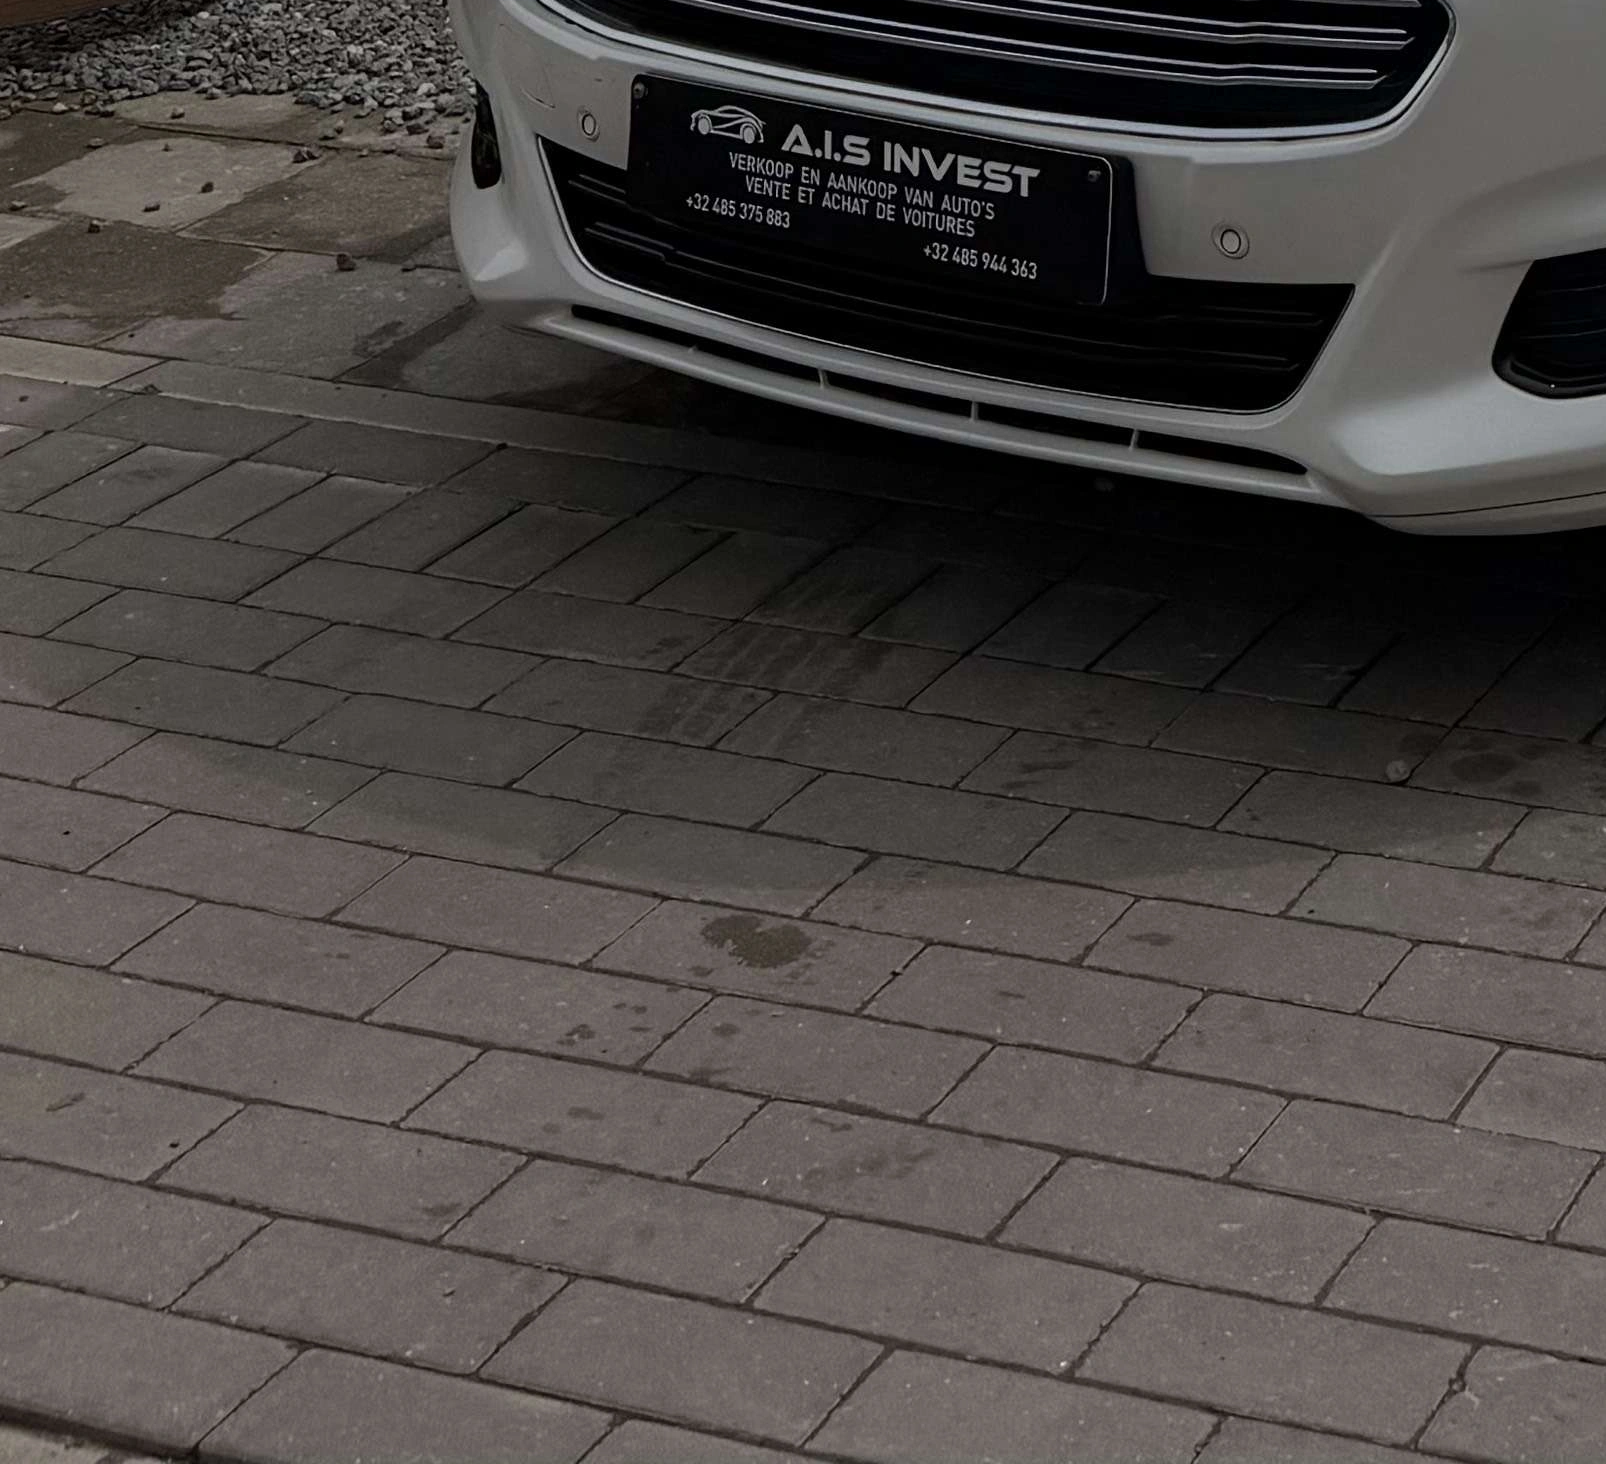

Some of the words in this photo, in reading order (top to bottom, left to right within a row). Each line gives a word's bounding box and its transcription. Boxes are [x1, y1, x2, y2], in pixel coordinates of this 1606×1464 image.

[728, 151, 795, 179] VERKOOP
[800, 166, 821, 186] EN
[827, 171, 898, 201] AANKOOP
[904, 185, 934, 209] VAN
[940, 193, 996, 220] AUTO'S
[780, 123, 871, 167] A.I.S
[883, 140, 1041, 198] INVEST
[685, 192, 710, 212] +32
[711, 197, 737, 217] 485
[739, 202, 764, 223] 375
[765, 207, 791, 229] 883
[745, 174, 791, 200] VENTE
[797, 186, 816, 205] ET
[821, 191, 870, 217] ACHAT
[875, 201, 897, 222] DE
[902, 206, 976, 238] VOITURES
[923, 241, 949, 262] +32
[952, 246, 979, 268] 485
[981, 252, 1008, 274] 944
[1010, 257, 1038, 280] 363
